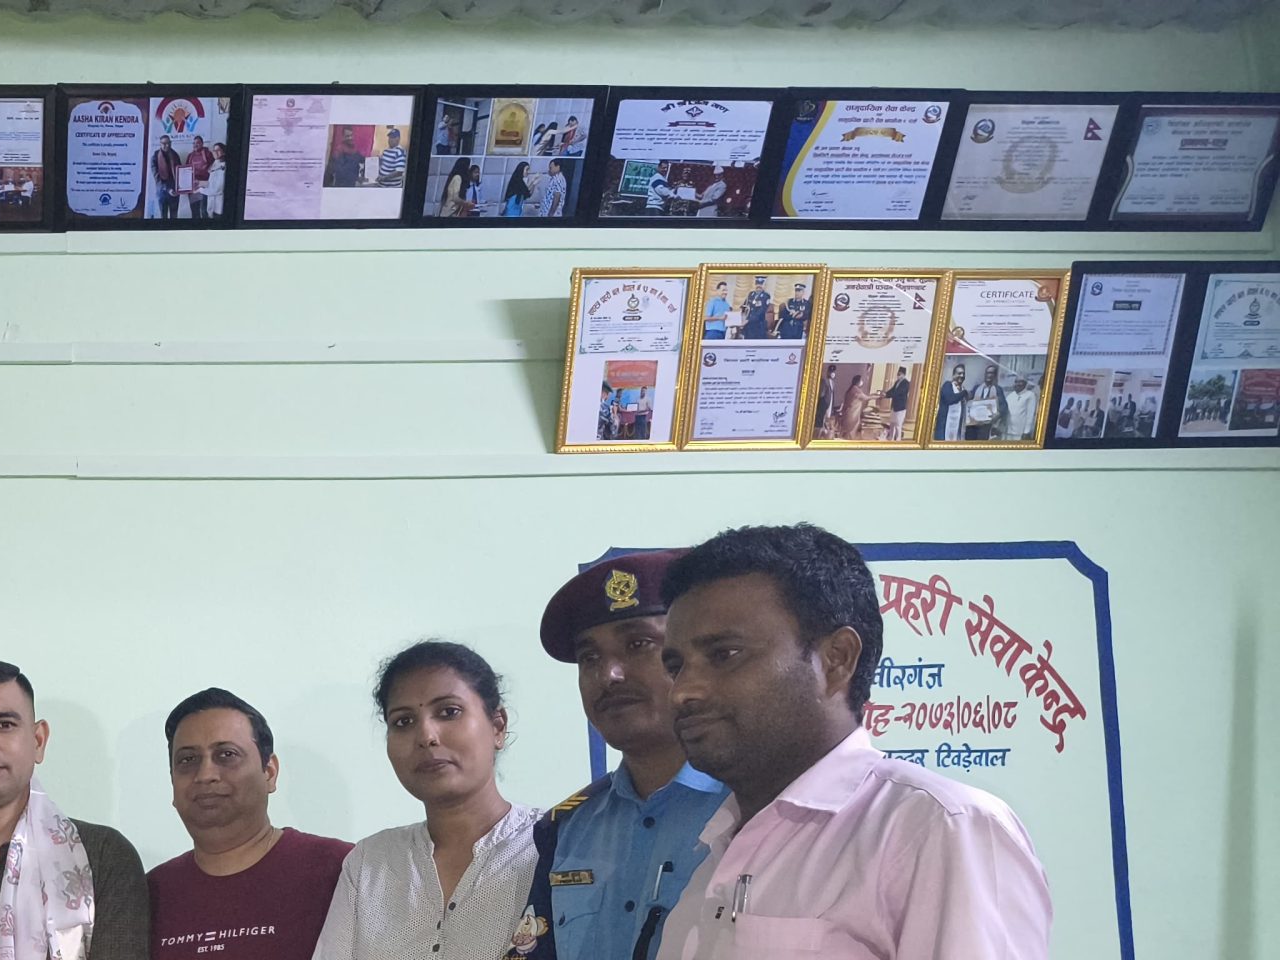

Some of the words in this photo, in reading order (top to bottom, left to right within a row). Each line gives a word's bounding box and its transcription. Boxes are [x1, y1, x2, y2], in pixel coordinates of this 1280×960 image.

[73, 115, 93, 123] AASHA
[94, 115, 114, 123] KIRAN
[114, 115, 139, 124] KENDRA
[980, 290, 1034, 299] CERTIFICATE
[878, 574, 963, 635] प्रहरी
[965, 594, 1032, 676] सेवा
[161, 933, 204, 946] TOMMY
[218, 925, 275, 939] HILFIGER
